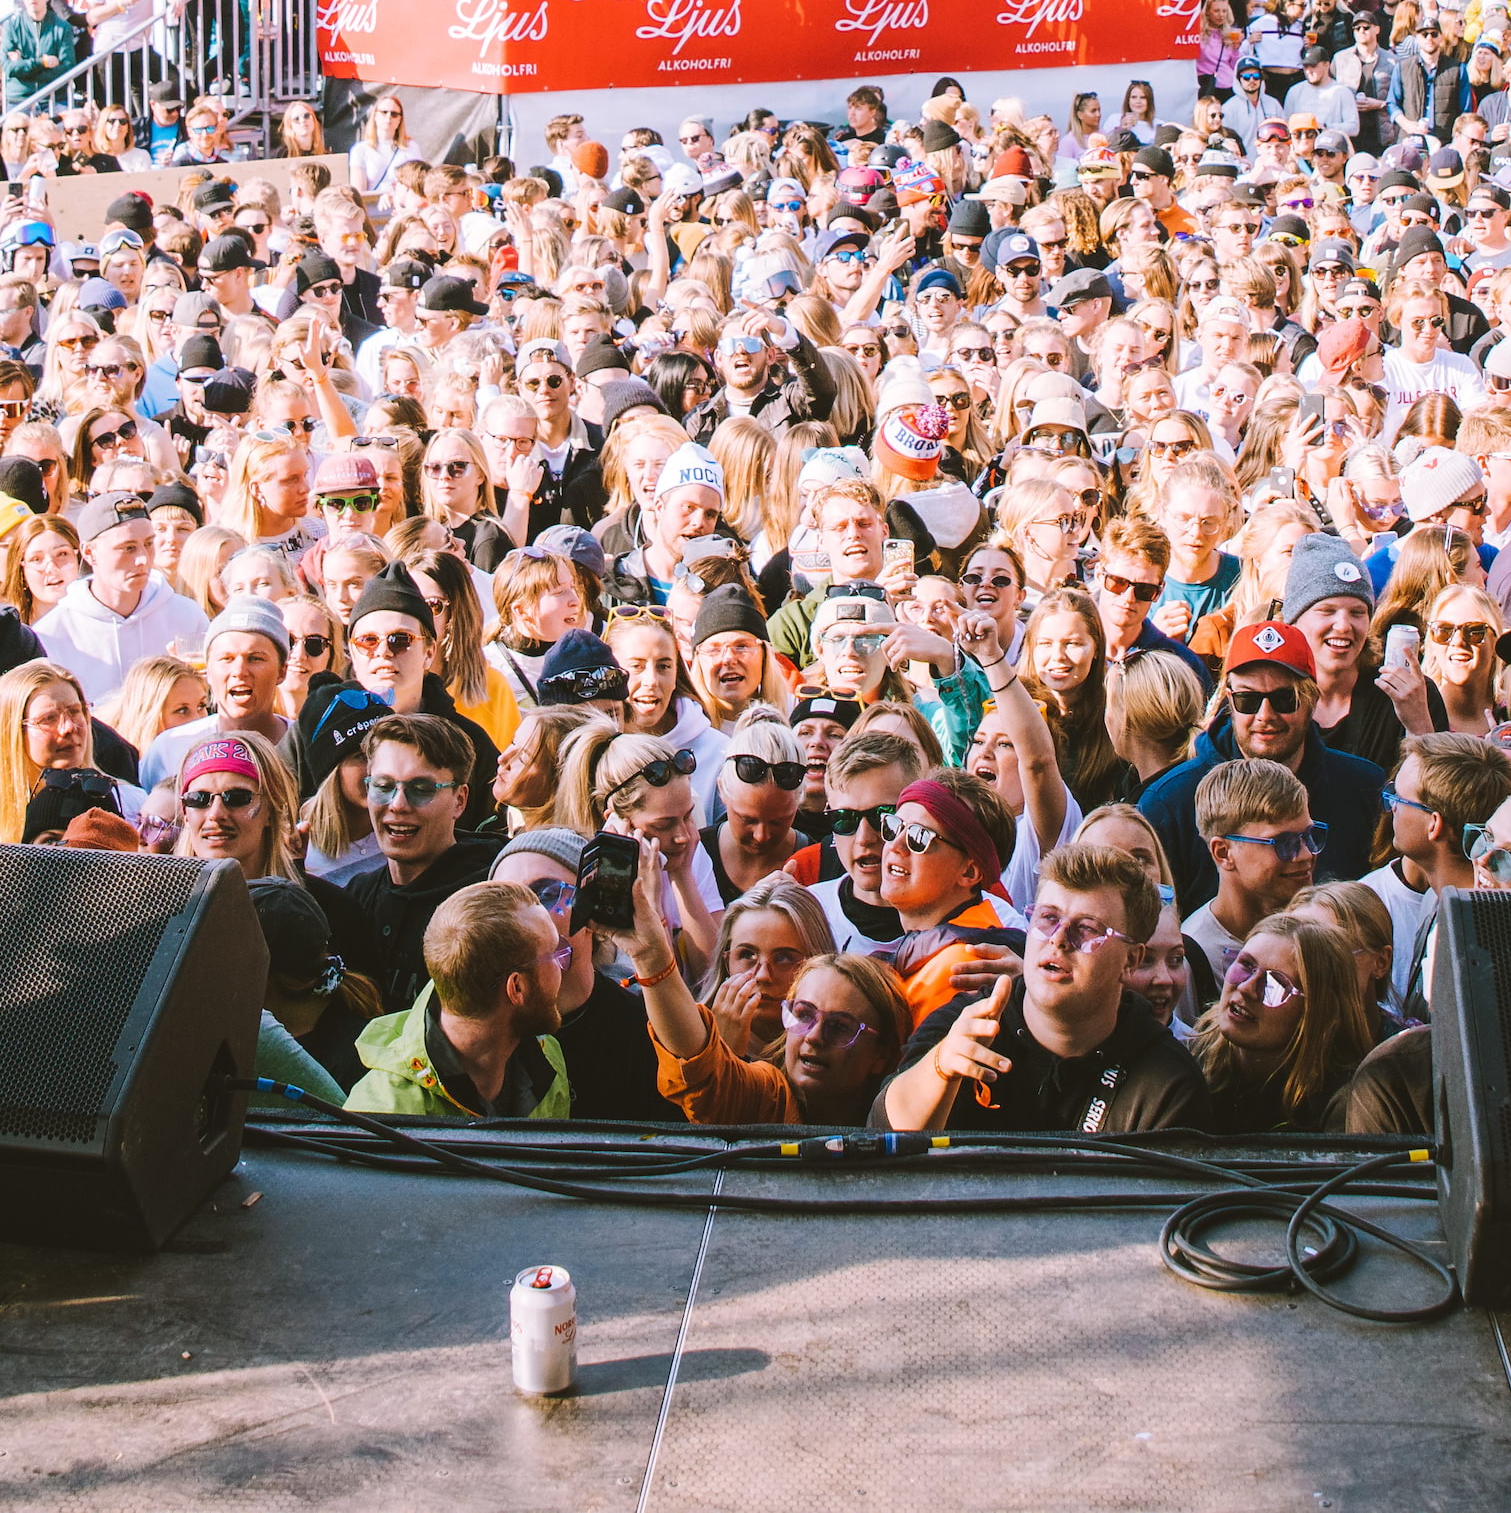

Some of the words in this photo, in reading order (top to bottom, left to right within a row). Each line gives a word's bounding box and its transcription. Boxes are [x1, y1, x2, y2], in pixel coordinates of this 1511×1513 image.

[1015, 41, 1076, 54] ALKOHOLFRI
[854, 49, 921, 62] ALKOHOLFRI
[471, 61, 537, 77] ALKOHOLFRI
[657, 57, 732, 71] ALKOHOLFRI
